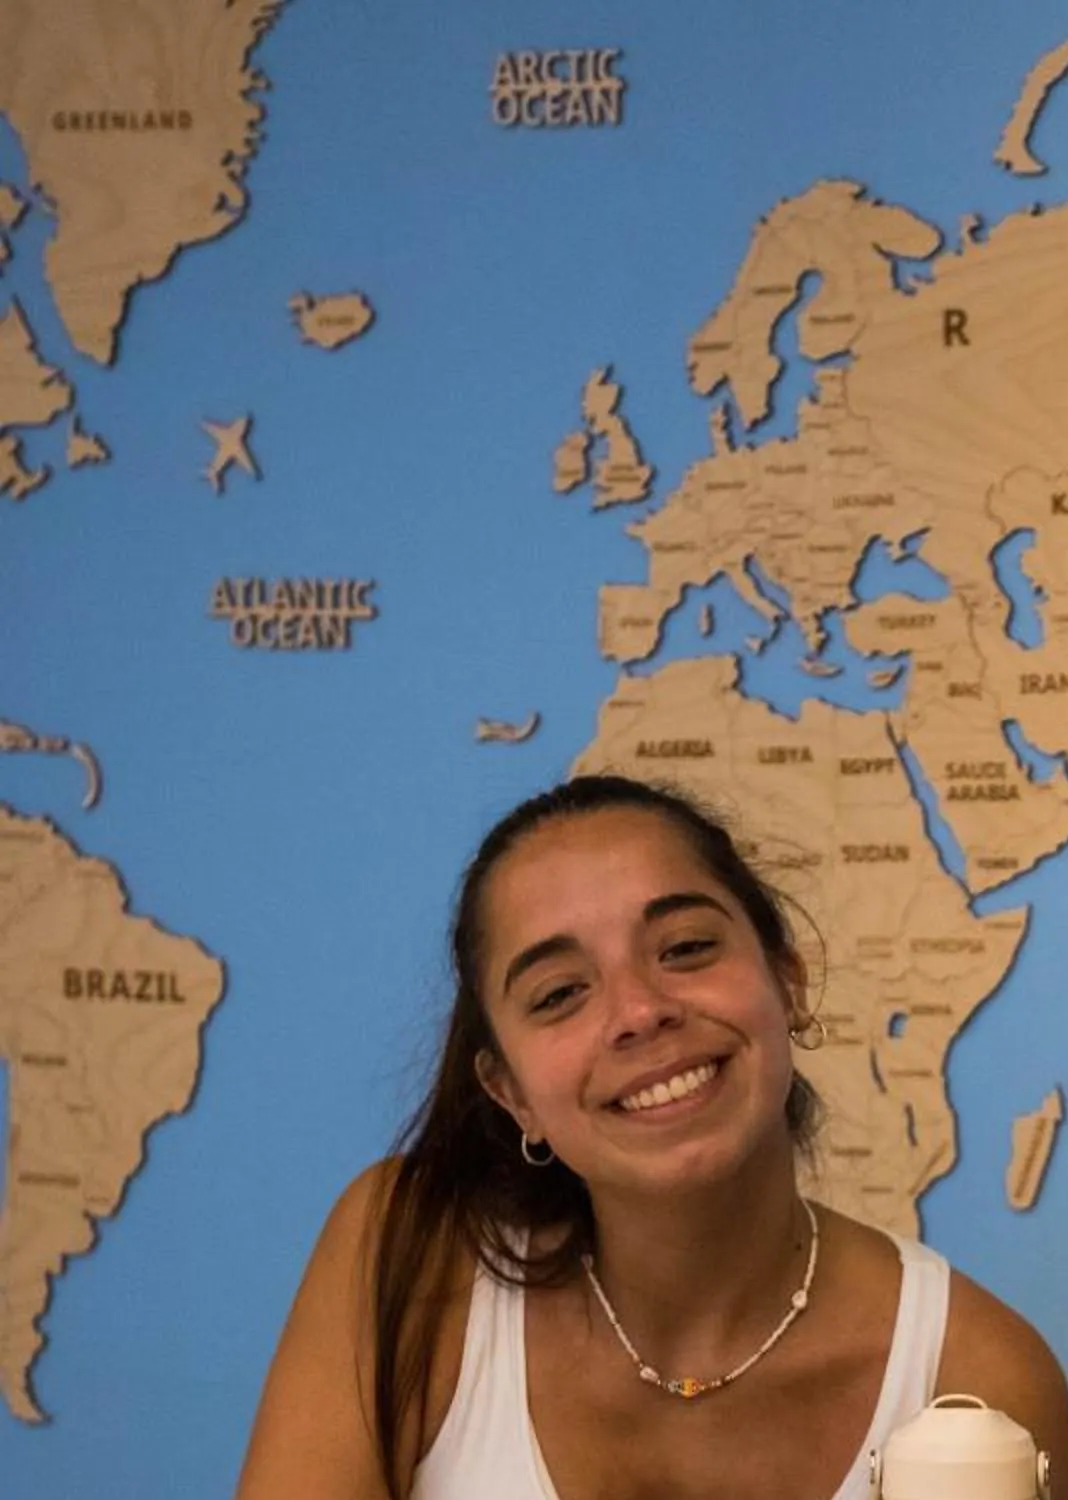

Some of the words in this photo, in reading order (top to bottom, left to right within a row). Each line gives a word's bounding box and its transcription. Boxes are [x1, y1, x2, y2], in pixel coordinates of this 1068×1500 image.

[491, 50, 622, 91] ARCTIC
[492, 89, 622, 125] OCEAN
[51, 109, 193, 132] GREENLAND
[210, 577, 376, 618] ATLANTIC
[230, 613, 351, 649] OCEAN
[634, 739, 716, 758] ALGERIA
[757, 745, 813, 764] LIBYA
[839, 757, 896, 775] EGYPT
[946, 784, 1020, 802] ARABIA
[840, 844, 910, 863] SUDAN
[62, 966, 187, 1004] BRAZIL
